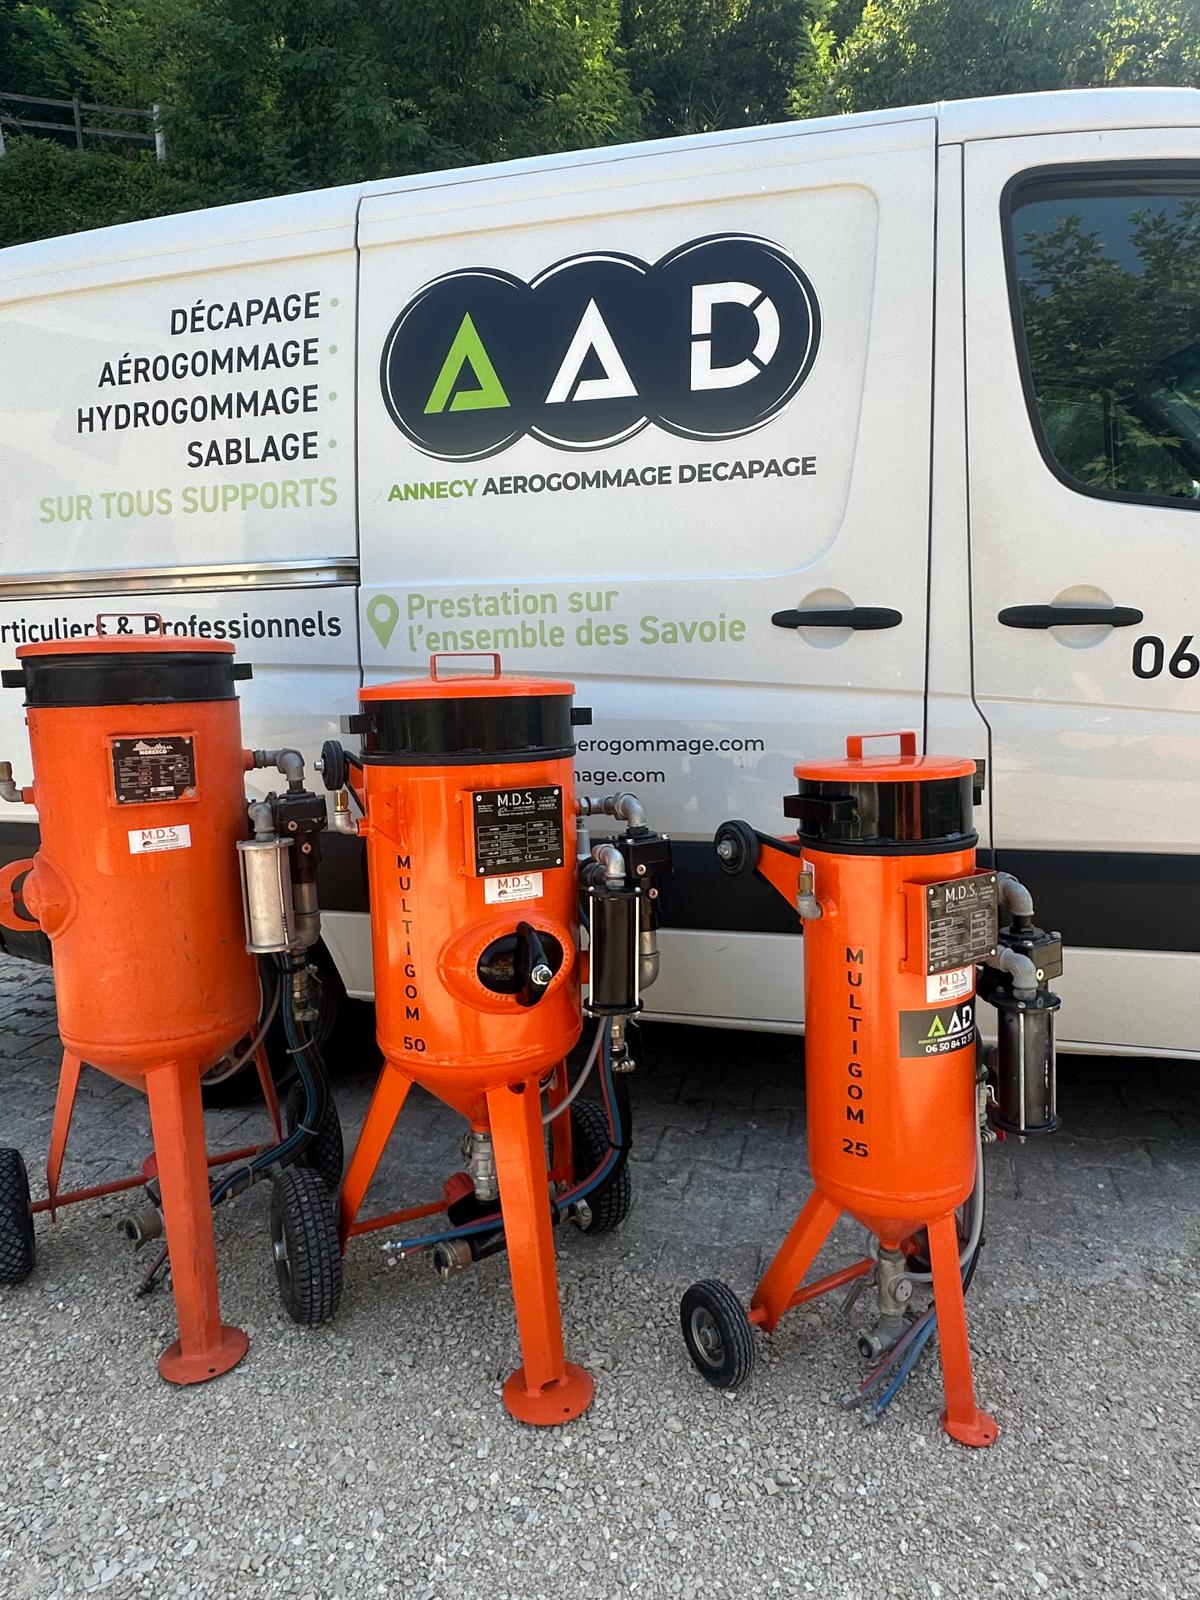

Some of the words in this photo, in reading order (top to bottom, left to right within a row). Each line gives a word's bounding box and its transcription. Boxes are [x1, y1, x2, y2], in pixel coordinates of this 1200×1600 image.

[171, 291, 320, 335] DÉCAPAGE
[98, 337, 319, 387] AÉROGOMMAGE
[77, 384, 318, 433] HYDROGOMMAGE
[187, 431, 318, 468] SABLAGE
[388, 479, 479, 502] ANNECY
[482, 465, 672, 497] AEROGOMMAGE
[678, 456, 817, 483] DECAPAGE
[40, 494, 93, 523] SUR
[100, 488, 173, 518] TOUS
[182, 477, 338, 514] SUPPORTS
[408, 588, 558, 621] Prestation
[568, 590, 620, 614] sur
[117, 616, 133, 635] &
[145, 610, 342, 638] Professionnels
[408, 616, 565, 652] l'ensemble
[575, 618, 629, 647] des
[640, 612, 746, 645] Savoie
[1132, 635, 1200, 680] 06
[497, 792, 535, 807] M.D.S.
[945, 883, 977, 902] M.D.S.
[397, 855, 419, 1021] MULTIGOM
[846, 947, 864, 1124] MULTIGOM
[927, 1005, 972, 1037] AAD
[403, 1036, 426, 1052] 50
[926, 1045, 938, 1053] 06
[939, 1043, 950, 1051] 50
[951, 1039, 960, 1048] 84
[842, 1138, 869, 1158] 25
